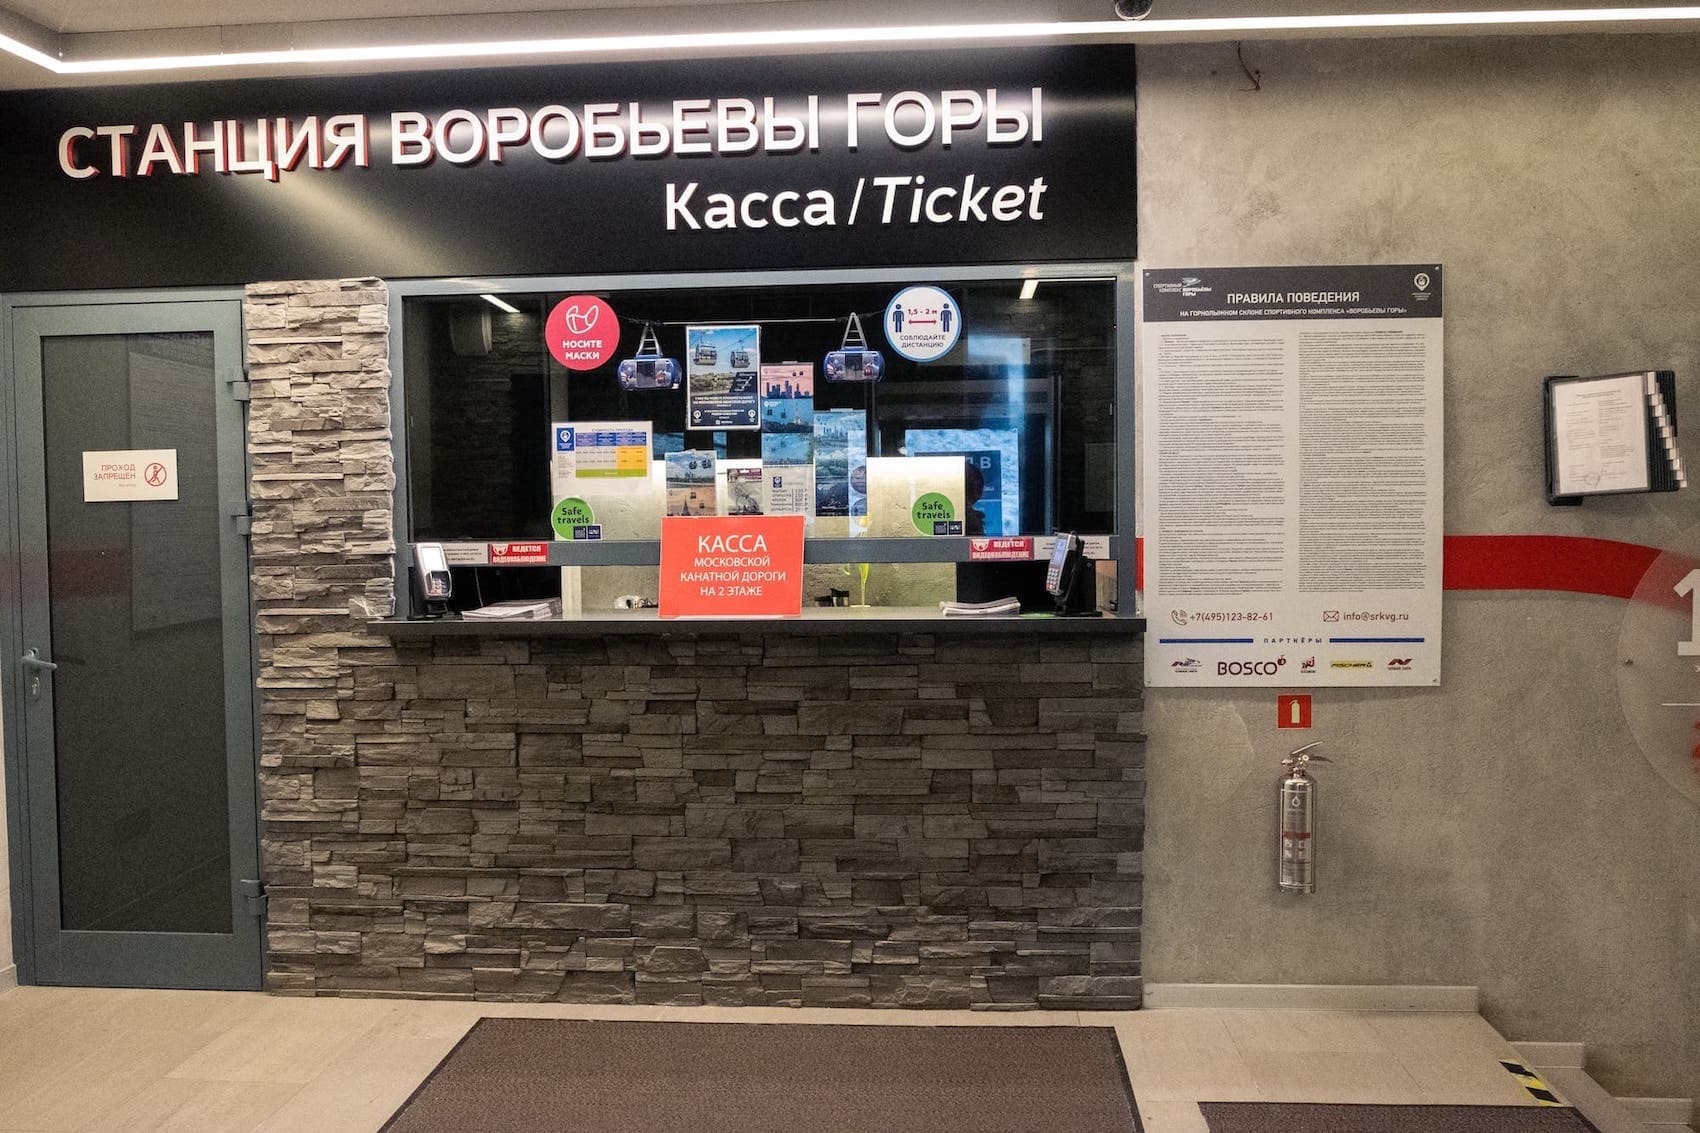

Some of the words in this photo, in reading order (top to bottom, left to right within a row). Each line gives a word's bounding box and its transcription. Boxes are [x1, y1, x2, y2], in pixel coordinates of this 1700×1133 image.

[58, 113, 369, 182] СТАНЦИЯ
[391, 95, 819, 166] ВОРОБЬЕВЫ
[847, 87, 1043, 152] ГОРЫ
[665, 182, 836, 231] Касса
[873, 174, 1048, 224] Ticket
[1227, 293, 1284, 304] ПРАВИЛА
[1286, 291, 1360, 304] ПОВЕДЕНИЯ
[562, 339, 603, 349] НОСИТЕ
[565, 351, 600, 360] МАСКИ
[561, 506, 582, 516] Safe
[921, 500, 944, 511] Safe
[557, 515, 590, 524] travels
[917, 510, 951, 519] travels
[698, 534, 767, 553] КАССА
[694, 556, 770, 567] МОСКОВСКОЙ
[680, 570, 739, 582] КАНАТНОЙ
[741, 571, 786, 582] ДОРОГИ
[700, 586, 715, 596] НА
[718, 586, 725, 596] 2
[727, 586, 763, 596] ЭТАЖЕ
[1189, 611, 1273, 622] +7(495)123-82-61
[1343, 611, 1409, 622] info@srkvg.ru
[1217, 661, 1278, 676] BOSCO
